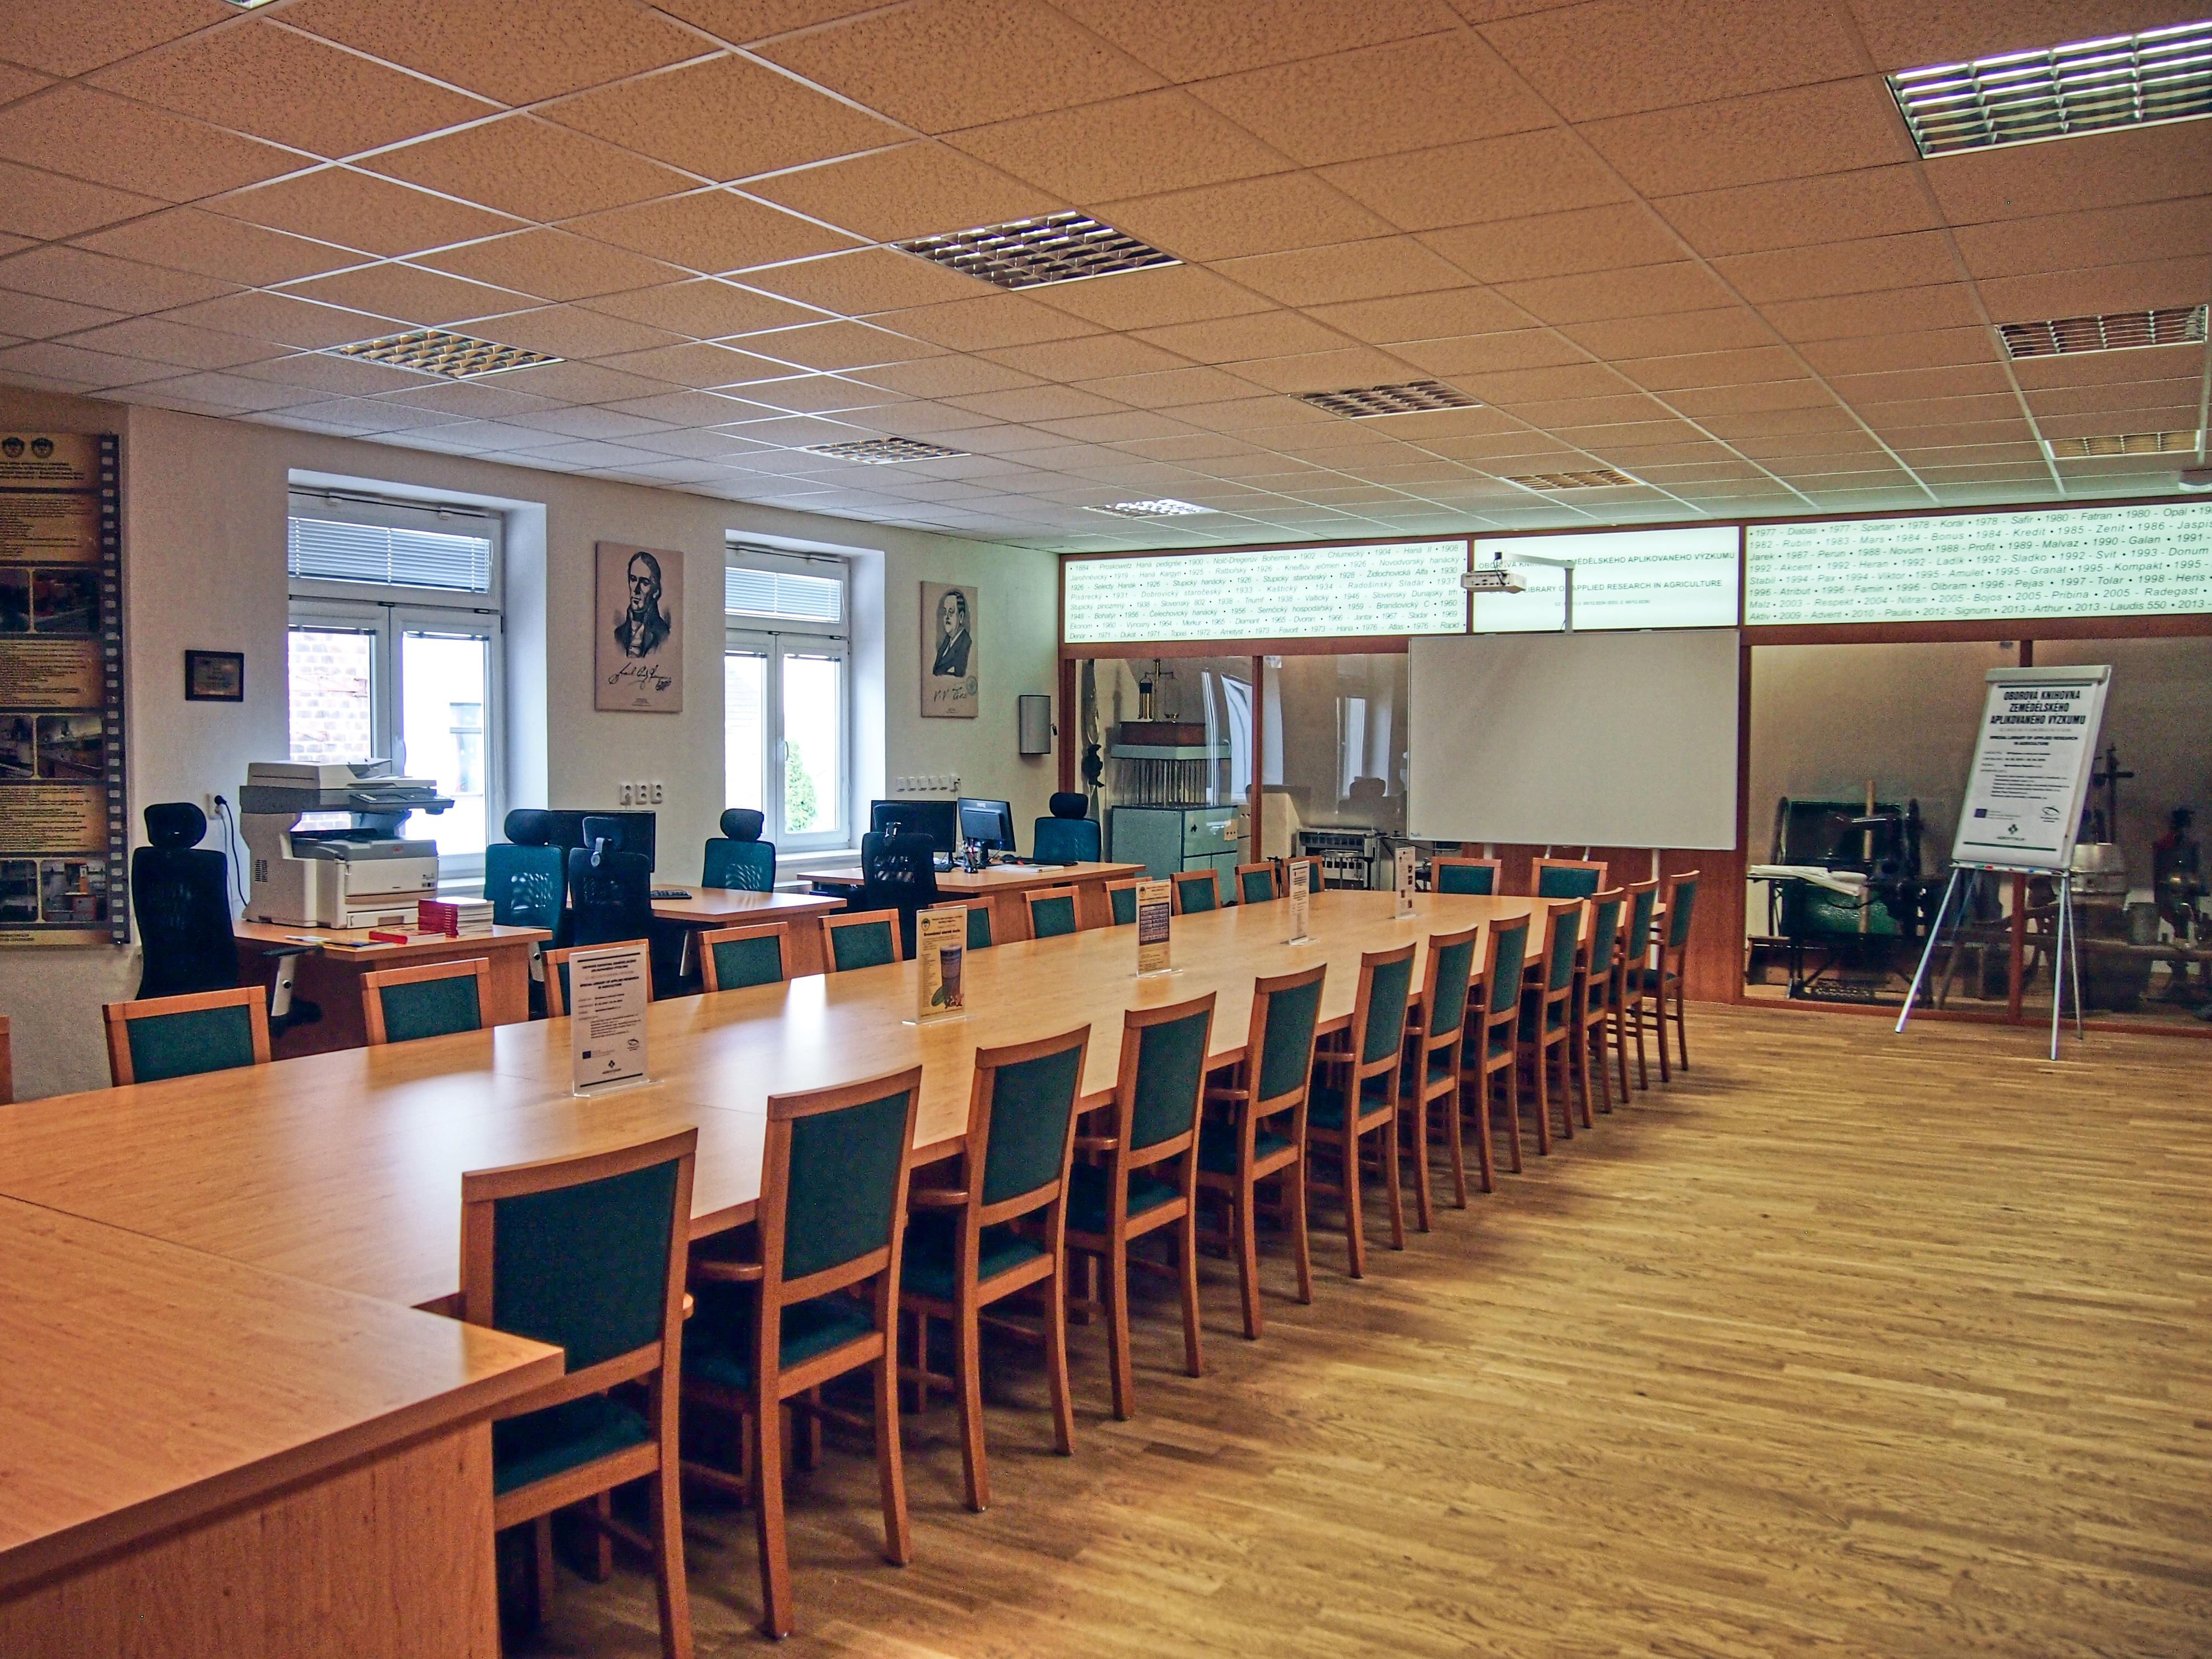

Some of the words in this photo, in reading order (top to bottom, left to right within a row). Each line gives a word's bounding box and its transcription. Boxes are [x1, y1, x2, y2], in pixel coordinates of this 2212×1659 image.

[1975, 517, 1998, 525] 1978
[2045, 514, 2069, 522] 1980
[2080, 512, 2112, 520] Fatran
[2126, 509, 2150, 518] 1980
[2163, 508, 2188, 518] Opál
[1896, 534, 1920, 542] 1984
[1931, 531, 1964, 540] Bonus
[1976, 530, 2001, 538] 1984
[2012, 528, 2046, 536] Kredit
[2058, 526, 2084, 534] 1985
[2095, 524, 2125, 533] Zenit
[2137, 522, 2165, 531] 1986
[1817, 549, 1845, 557] Perun
[1936, 544, 1959, 552] 1988
[1968, 542, 1995, 551] Profit
[2008, 541, 2032, 549] 1989
[2042, 539, 2079, 548] Malvaz
[2093, 537, 2119, 546] 1990
[2128, 535, 2161, 544] Galan
[2177, 534, 2203, 542] 1991
[1627, 554, 1692, 562] APLIKOVANÉHO
[1694, 552, 1735, 560] VÝZKUMU
[2011, 554, 2047, 562] Sladko
[2059, 552, 2085, 560] 1992
[2096, 550, 2116, 559] Svit
[2131, 549, 2157, 557] 1993
[2168, 546, 2209, 556] Donum
[1915, 570, 1939, 578] 1995
[1995, 567, 2020, 576] 1995
[2030, 566, 2066, 574] Granát
[2078, 564, 2103, 572] 1995
[2114, 562, 2163, 573] Kompakt
[2174, 560, 2201, 569] 1995
[1663, 580, 1723, 588] AGRICULTURE
[2015, 579, 2044, 589] Pejas
[2060, 577, 2086, 586] 1997
[2098, 576, 2124, 585] Tolar
[2138, 575, 2165, 583] 1998
[2176, 573, 2206, 582] Heris
[1973, 593, 2002, 603] Bojos
[2051, 591, 2088, 599] Pribina
[2103, 589, 2130, 598] 2005
[2144, 587, 2198, 598] Radegast
[1954, 606, 1990, 617] Signum
[2110, 602, 2144, 611] Laudis
[2147, 601, 2166, 609] 550
[2009, 701, 2069, 712] ZEMĚDĚLSKÉHO
[1990, 713, 2046, 724] APLIKOVANÉHO
[2048, 713, 2086, 724] VÝZKUMU
